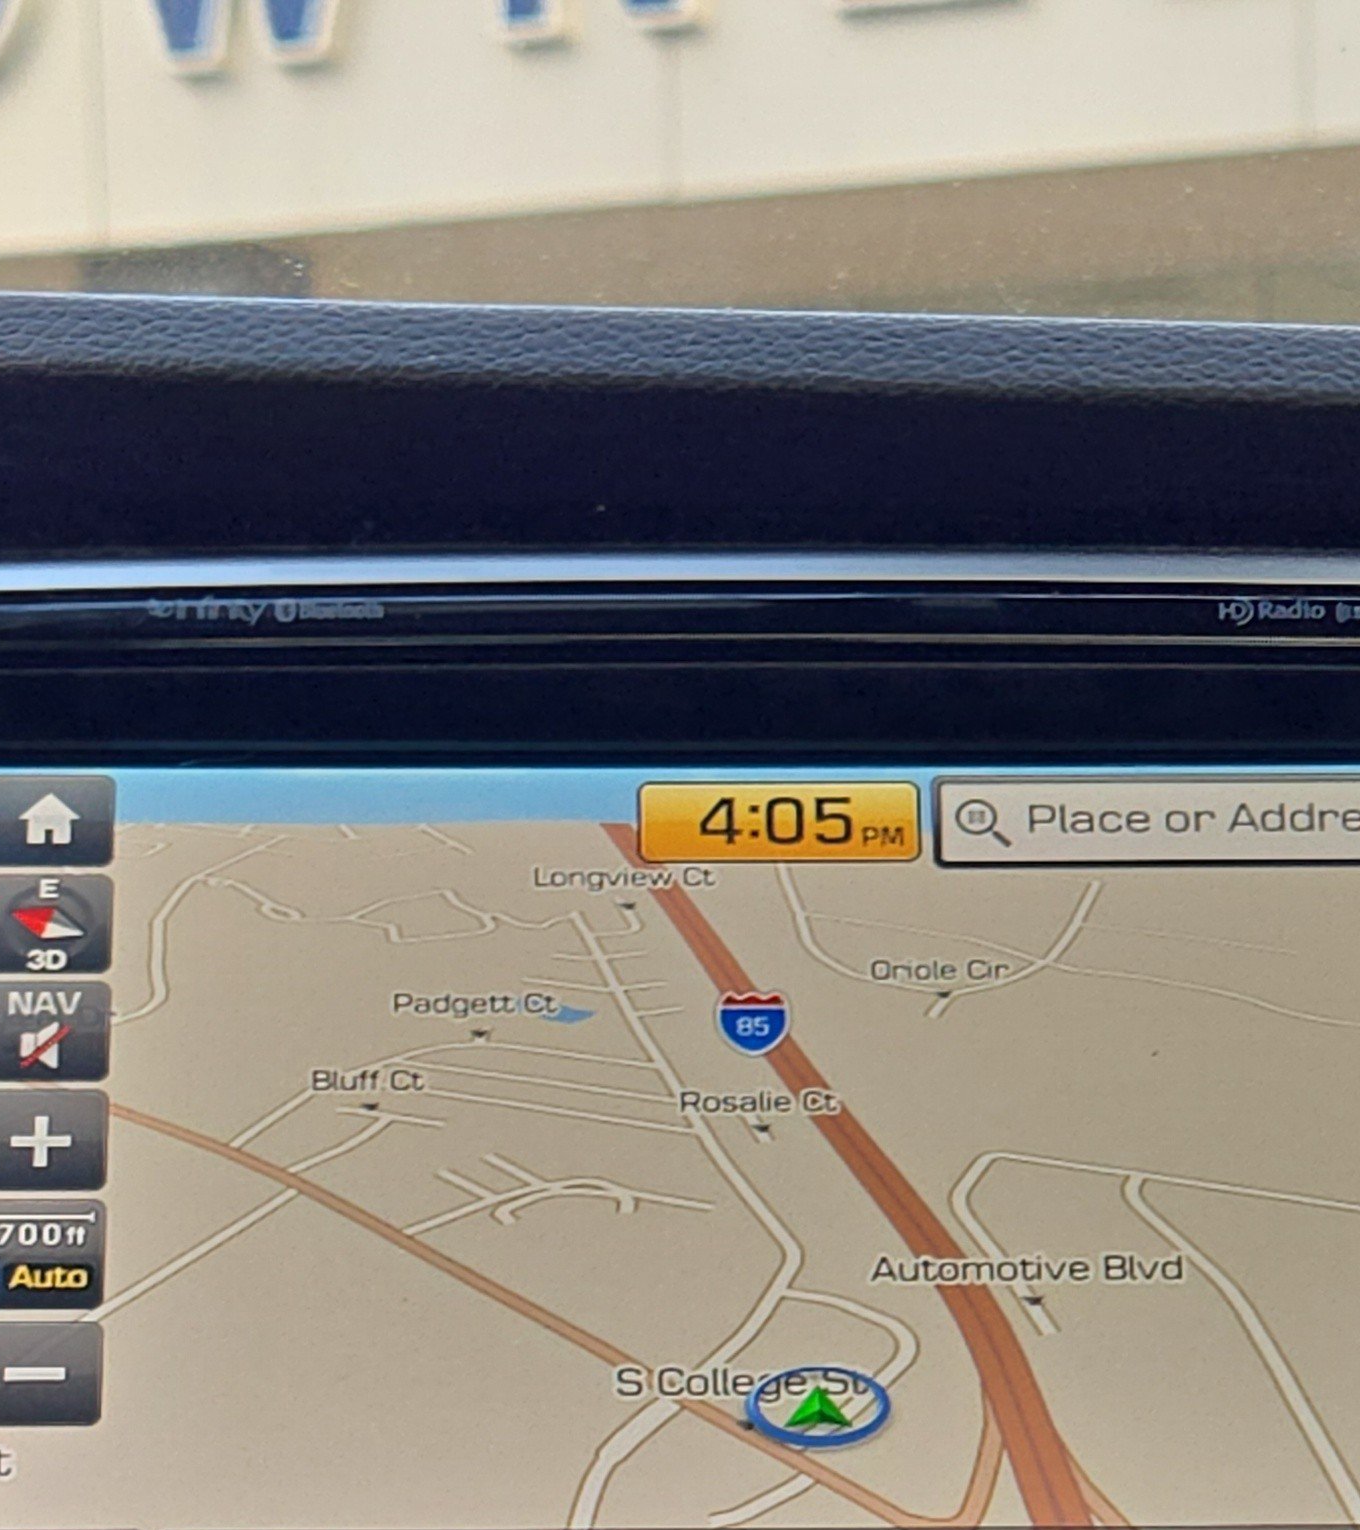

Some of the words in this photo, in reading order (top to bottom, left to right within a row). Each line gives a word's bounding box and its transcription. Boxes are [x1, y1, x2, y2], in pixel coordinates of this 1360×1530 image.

[1258, 600, 1326, 620] Radio
[699, 796, 854, 846] 4:05
[861, 825, 905, 848] PM
[1026, 801, 1151, 835] Place
[1165, 807, 1217, 835] or
[38, 878, 60, 899] E
[532, 867, 673, 892] Longview
[682, 866, 716, 888] Ct
[25, 948, 68, 971] 3D
[967, 958, 1010, 981] Cir
[6, 990, 83, 1016] NAV
[392, 992, 517, 1018] Padgett
[522, 992, 558, 1016] Ct
[736, 1016, 770, 1038] 85
[310, 1069, 382, 1091] Bluff
[389, 1069, 425, 1091] Ct
[678, 1090, 792, 1113] Rosalie
[802, 1090, 838, 1113] Ct
[8, 1264, 89, 1290] Auto
[870, 1255, 1092, 1283] Automotive
[1103, 1254, 1184, 1281] Blvd
[615, 1367, 644, 1396] S
[656, 1366, 809, 1402] College
